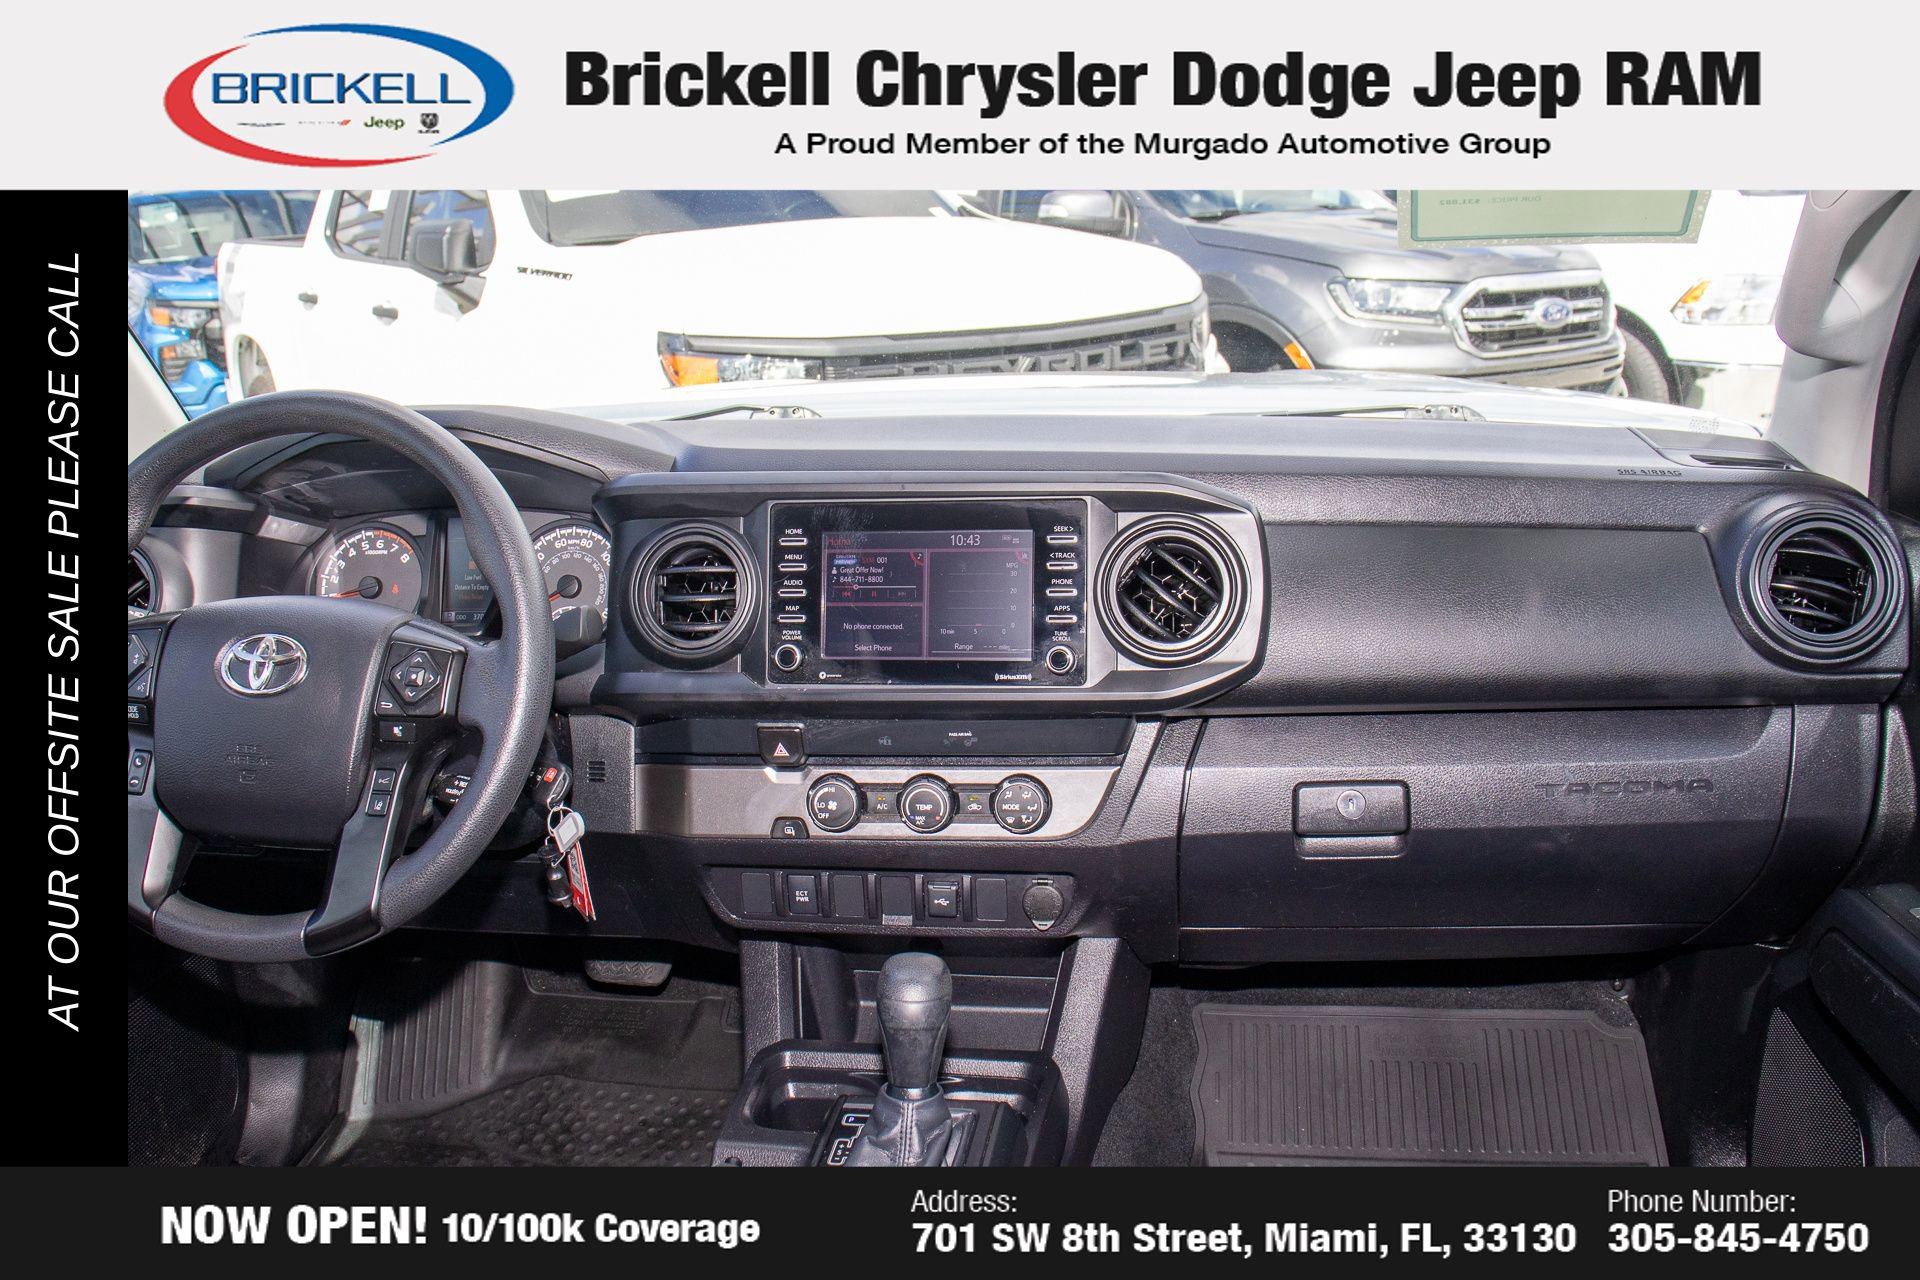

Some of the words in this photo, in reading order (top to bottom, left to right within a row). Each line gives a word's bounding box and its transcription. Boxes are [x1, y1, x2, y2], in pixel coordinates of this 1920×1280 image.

[848, 336, 1199, 378] VROLET
[376, 540, 385, 549] 6
[555, 538, 567, 548] 60
[580, 538, 593, 548] 80
[950, 534, 981, 546] 10:43
[361, 541, 370, 551] 5
[390, 543, 399, 552] 7
[348, 547, 356, 558] 4
[400, 553, 410, 564] 8
[336, 559, 346, 570] 3
[329, 575, 339, 584] 2
[843, 622, 853, 630] No
[854, 622, 872, 631] phone
[872, 622, 905, 630] connected.
[954, 642, 974, 650] Range
[1534, 779, 1714, 800] TACOMA
